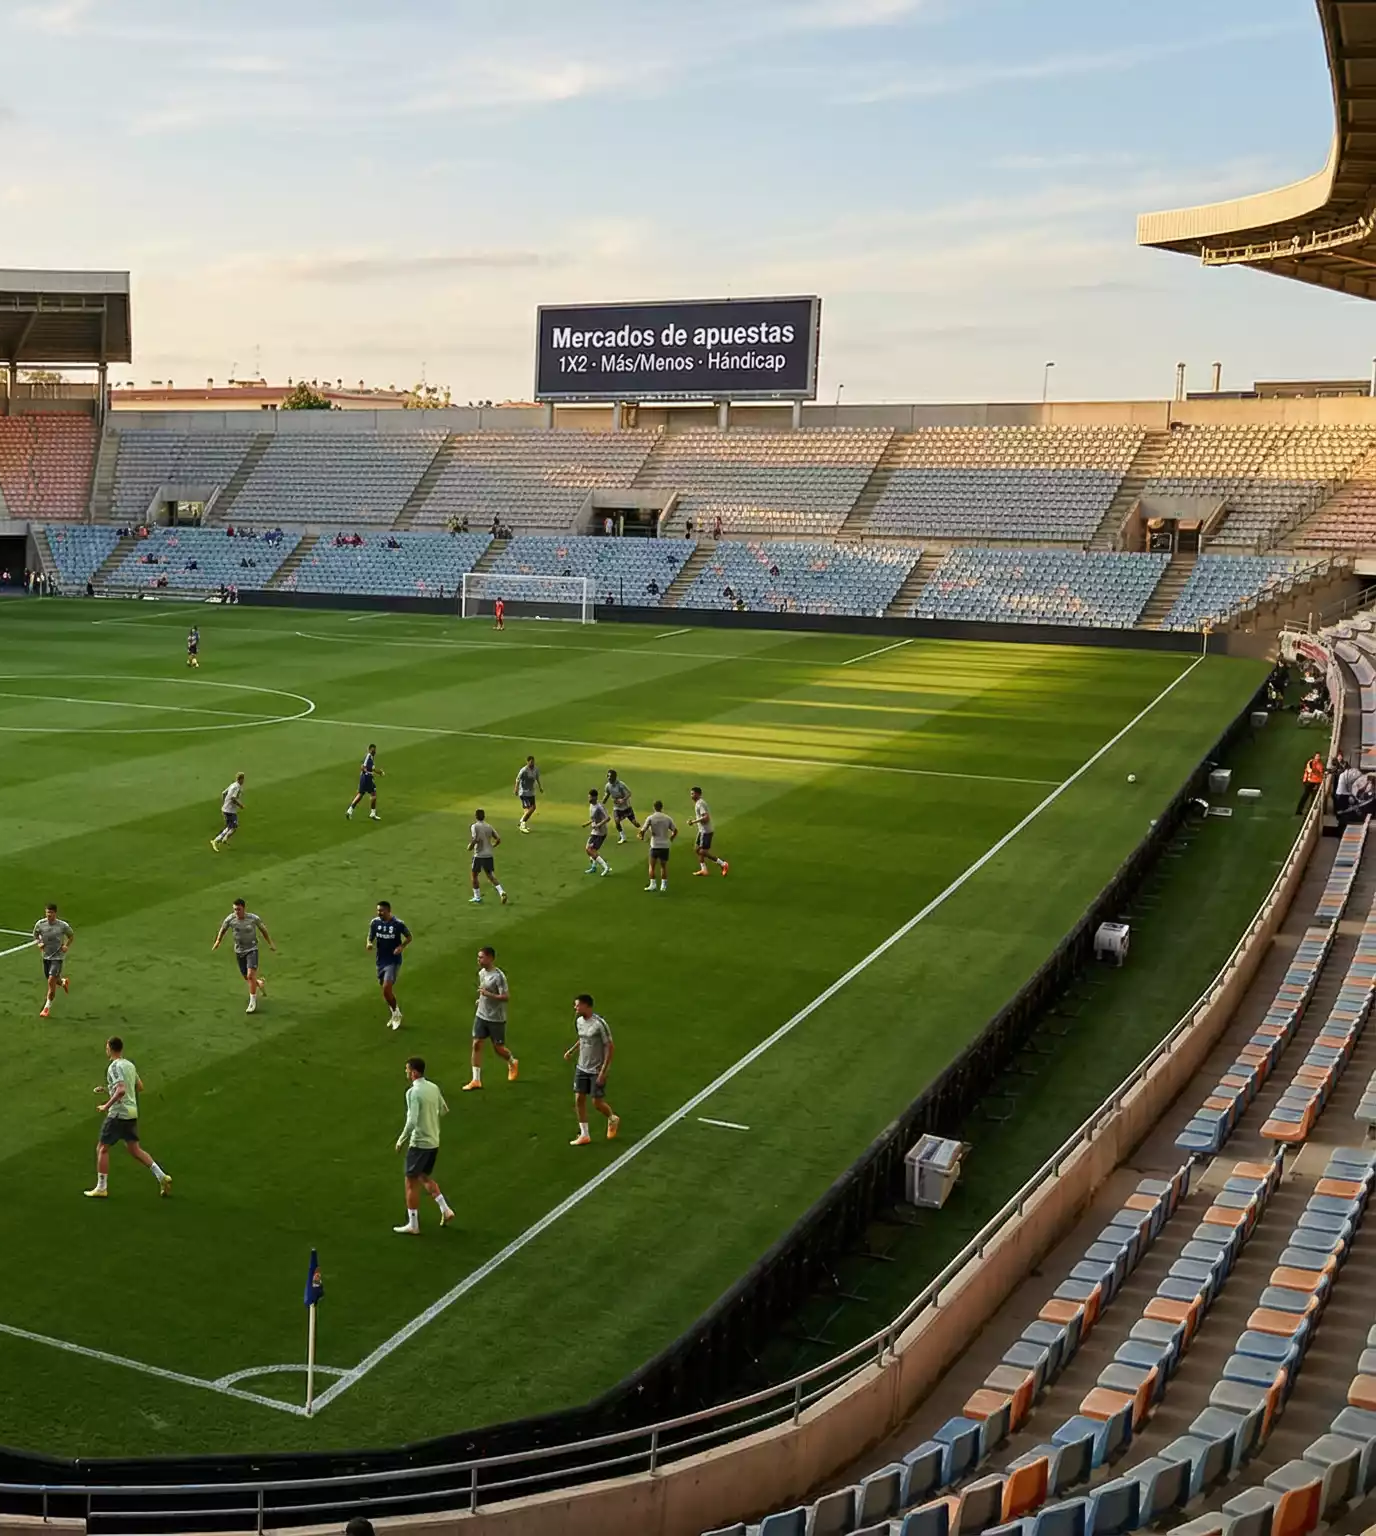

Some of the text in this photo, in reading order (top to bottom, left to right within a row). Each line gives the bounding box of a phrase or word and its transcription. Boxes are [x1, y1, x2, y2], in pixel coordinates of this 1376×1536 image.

[552, 321, 795, 350] Mercados de apuestas
[558, 355, 588, 373] 1X2
[600, 352, 694, 373] Más/Menos
[707, 350, 786, 372] Hándicap
